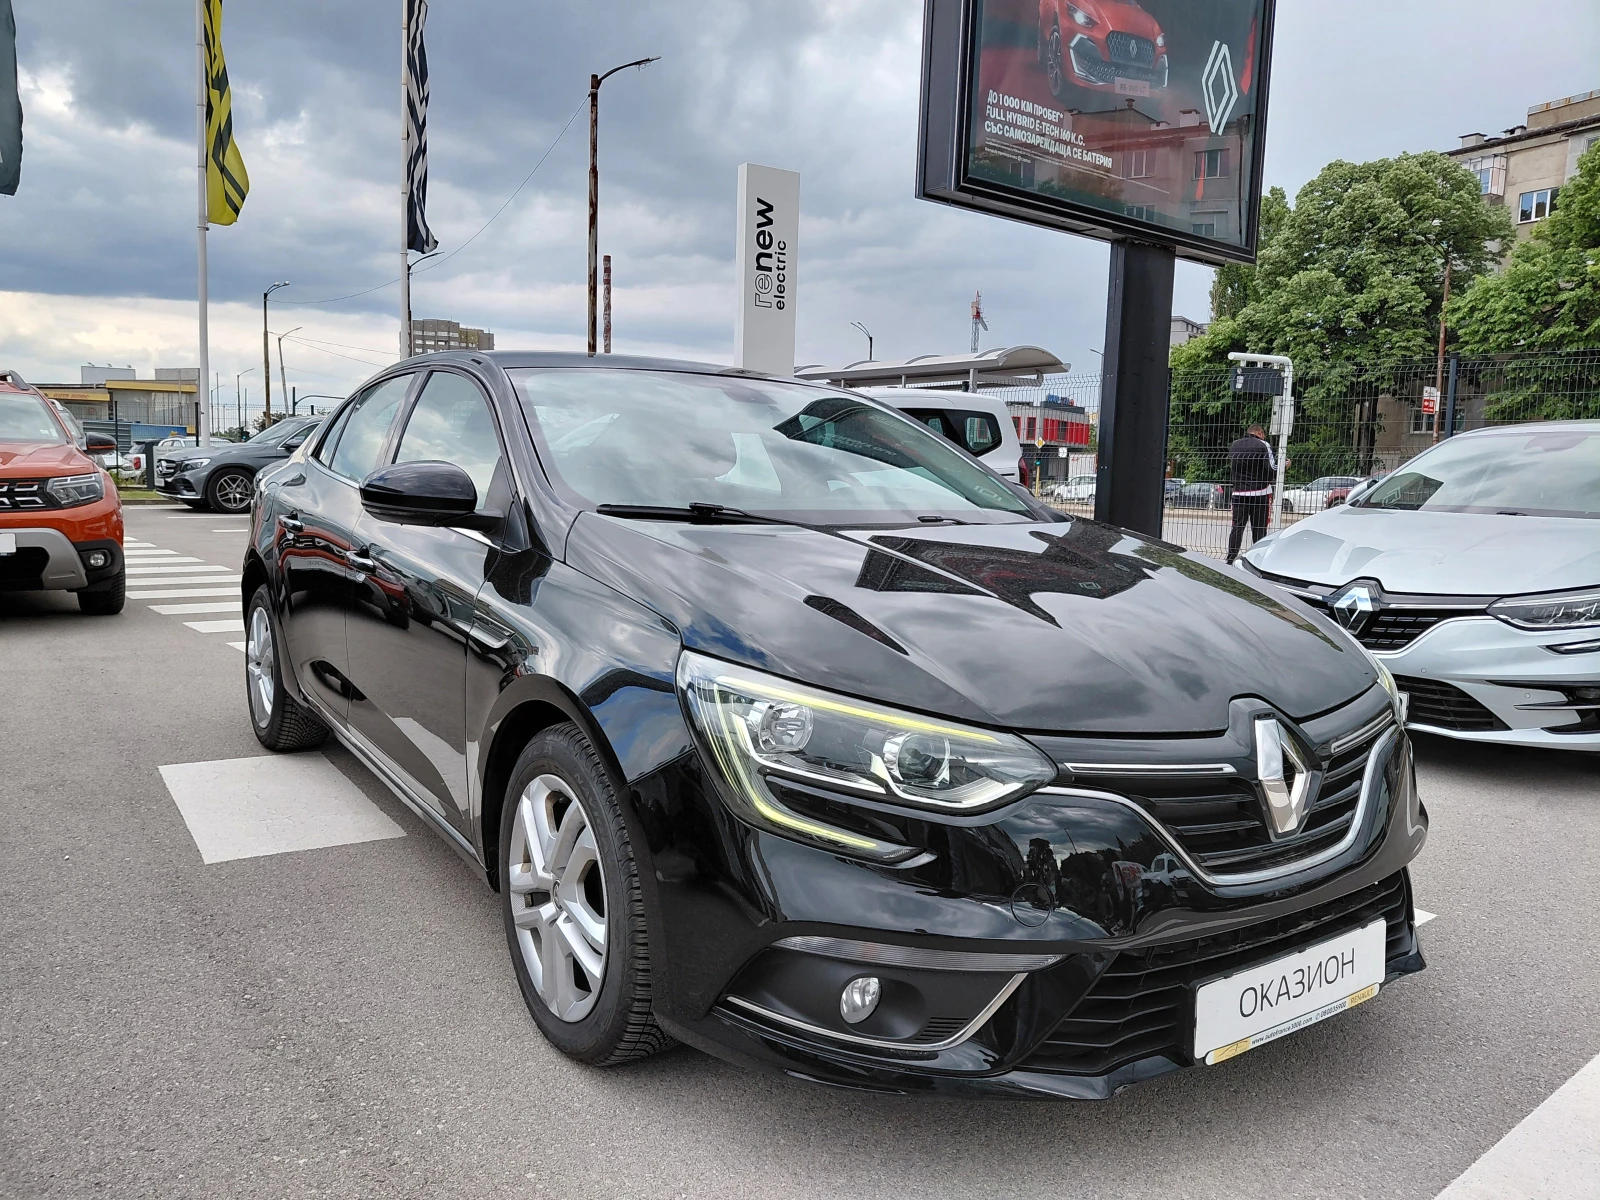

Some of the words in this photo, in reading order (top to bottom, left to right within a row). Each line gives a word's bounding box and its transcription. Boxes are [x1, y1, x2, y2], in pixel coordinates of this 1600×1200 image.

[985, 105, 1005, 121] FULL
[1006, 111, 1035, 129] HYBRID
[1035, 119, 1060, 139] E-TECH
[1060, 128, 1071, 142] 160
[987, 89, 998, 105] ДО
[1021, 100, 1033, 114] КМ
[984, 120, 1003, 135] СЪС
[1004, 125, 1071, 158] САМОЗАРЕЖДАЩА
[1072, 148, 1082, 160] СЕ
[1082, 149, 1113, 168] БАТЕРИЯ
[754, 196, 774, 309] renew
[773, 240, 787, 311] electric
[1239, 947, 1355, 1018] ОКАЗИОН
[1350, 988, 1374, 1005] RENAULT
